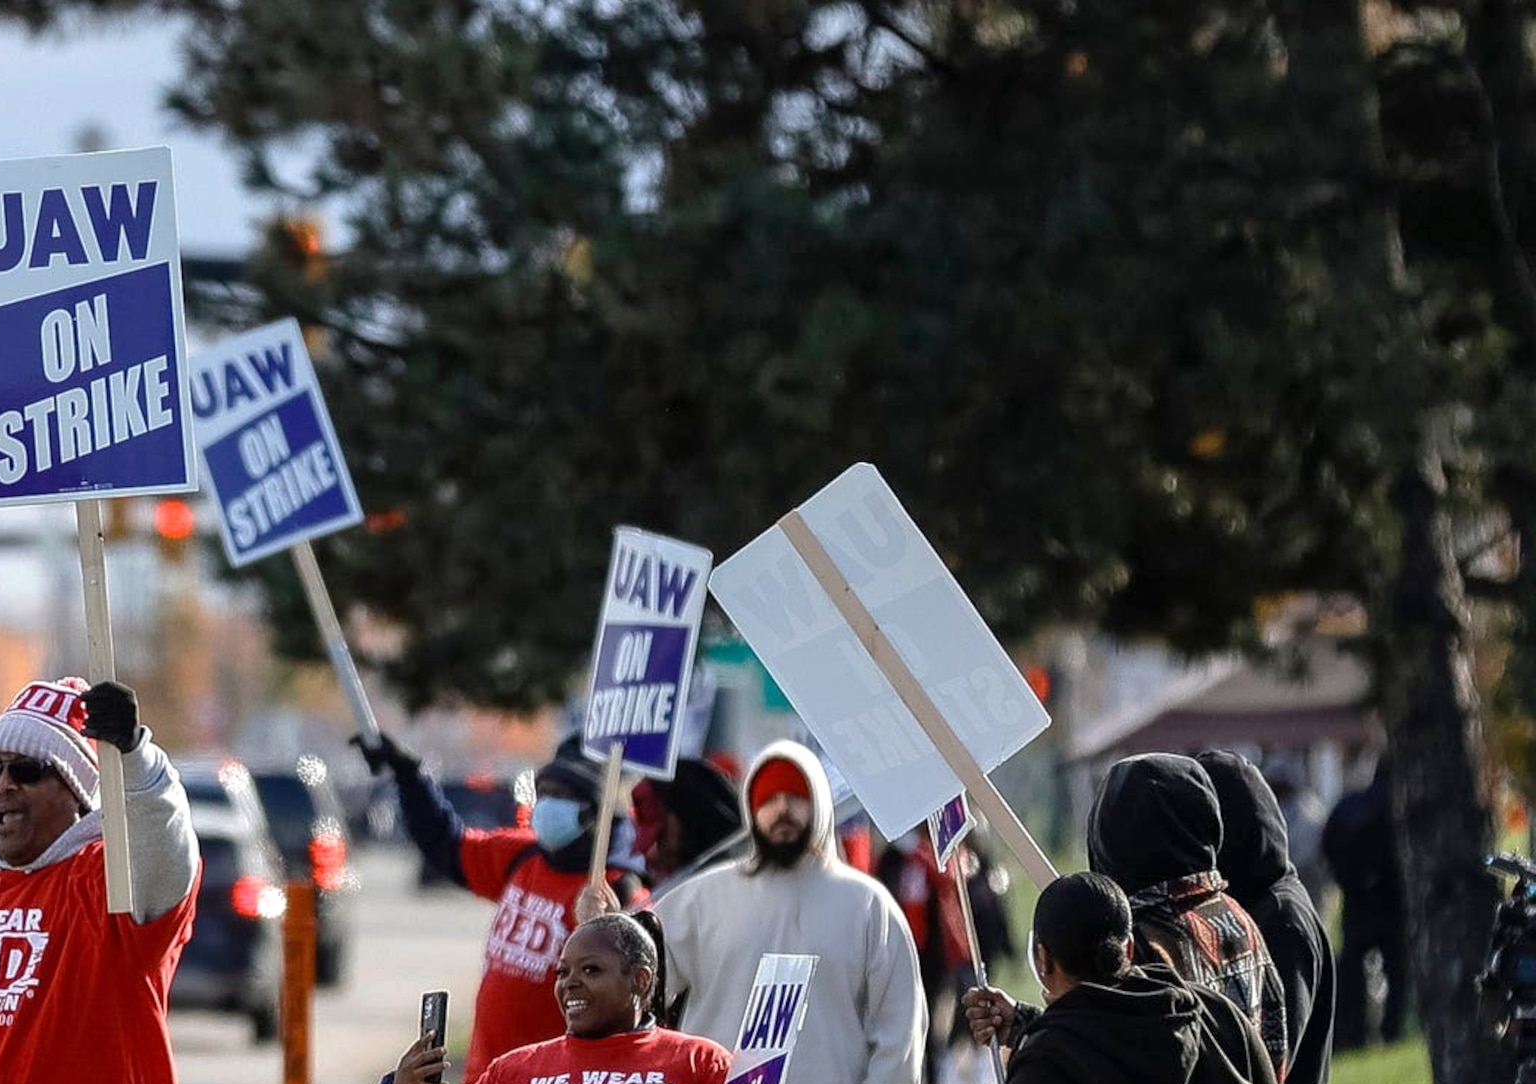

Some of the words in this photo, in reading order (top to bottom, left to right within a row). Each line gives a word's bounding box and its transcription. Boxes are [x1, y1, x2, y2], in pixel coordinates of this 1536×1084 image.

[40, 294, 112, 383] ON
[190, 344, 293, 418] UAW
[239, 412, 291, 480] ON
[227, 441, 337, 548] STRIKE
[615, 547, 698, 618] UAW
[613, 631, 653, 684] ON
[588, 683, 675, 740] STRIKE
[493, 905, 550, 954] RED
